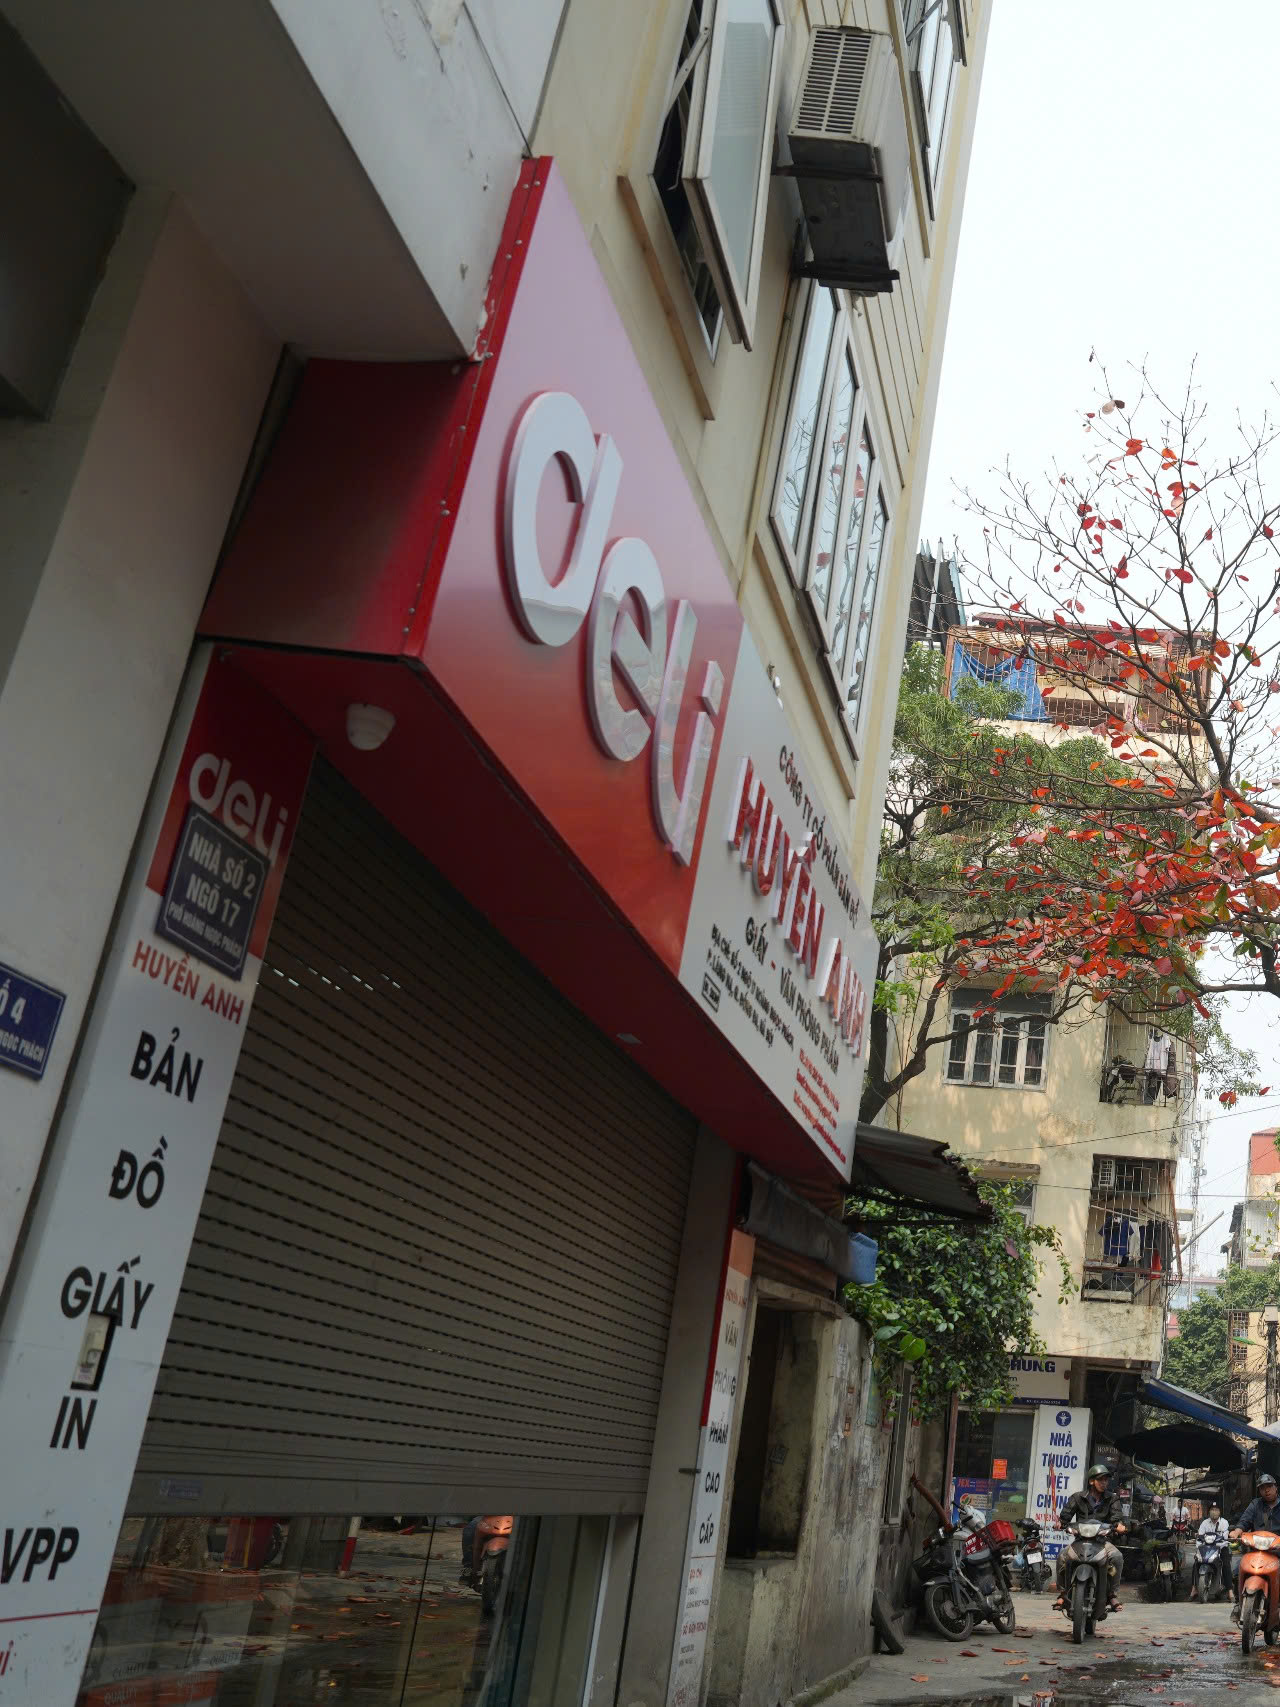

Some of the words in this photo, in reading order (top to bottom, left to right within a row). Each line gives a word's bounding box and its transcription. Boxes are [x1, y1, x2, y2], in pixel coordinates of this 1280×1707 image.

[503, 391, 727, 866] deli
[189, 752, 289, 867] deli
[779, 745, 803, 807] CÔNG
[802, 794, 813, 827] TY
[187, 831, 222, 877] NHÀ
[221, 856, 248, 891] SỐ
[242, 872, 258, 898] 2
[185, 873, 224, 916] NGÕ
[222, 898, 242, 929] 17
[728, 756, 825, 980] HUYỀN
[817, 937, 866, 1058] ANH
[131, 940, 201, 1001] HUYỀN
[202, 982, 245, 1025] ANH
[10, 996, 27, 1025] 4
[130, 1027, 203, 1103] BẢN
[109, 1135, 170, 1208] ĐỒ
[60, 1256, 154, 1330] GIẤY
[725, 1320, 738, 1348] VĂN
[714, 1369, 737, 1397] PHÒNG
[1008, 1358, 1057, 1373] HUNG
[50, 1397, 97, 1450] IN
[708, 1411, 729, 1445] PHẨM
[1049, 1430, 1073, 1448] NHÀ
[705, 1471, 721, 1493] CAO
[1042, 1450, 1078, 1469] THUỐC
[698, 1511, 715, 1544] CẤP
[1037, 1493, 1071, 1510] CHUN
[0, 1526, 80, 1584] VPP
